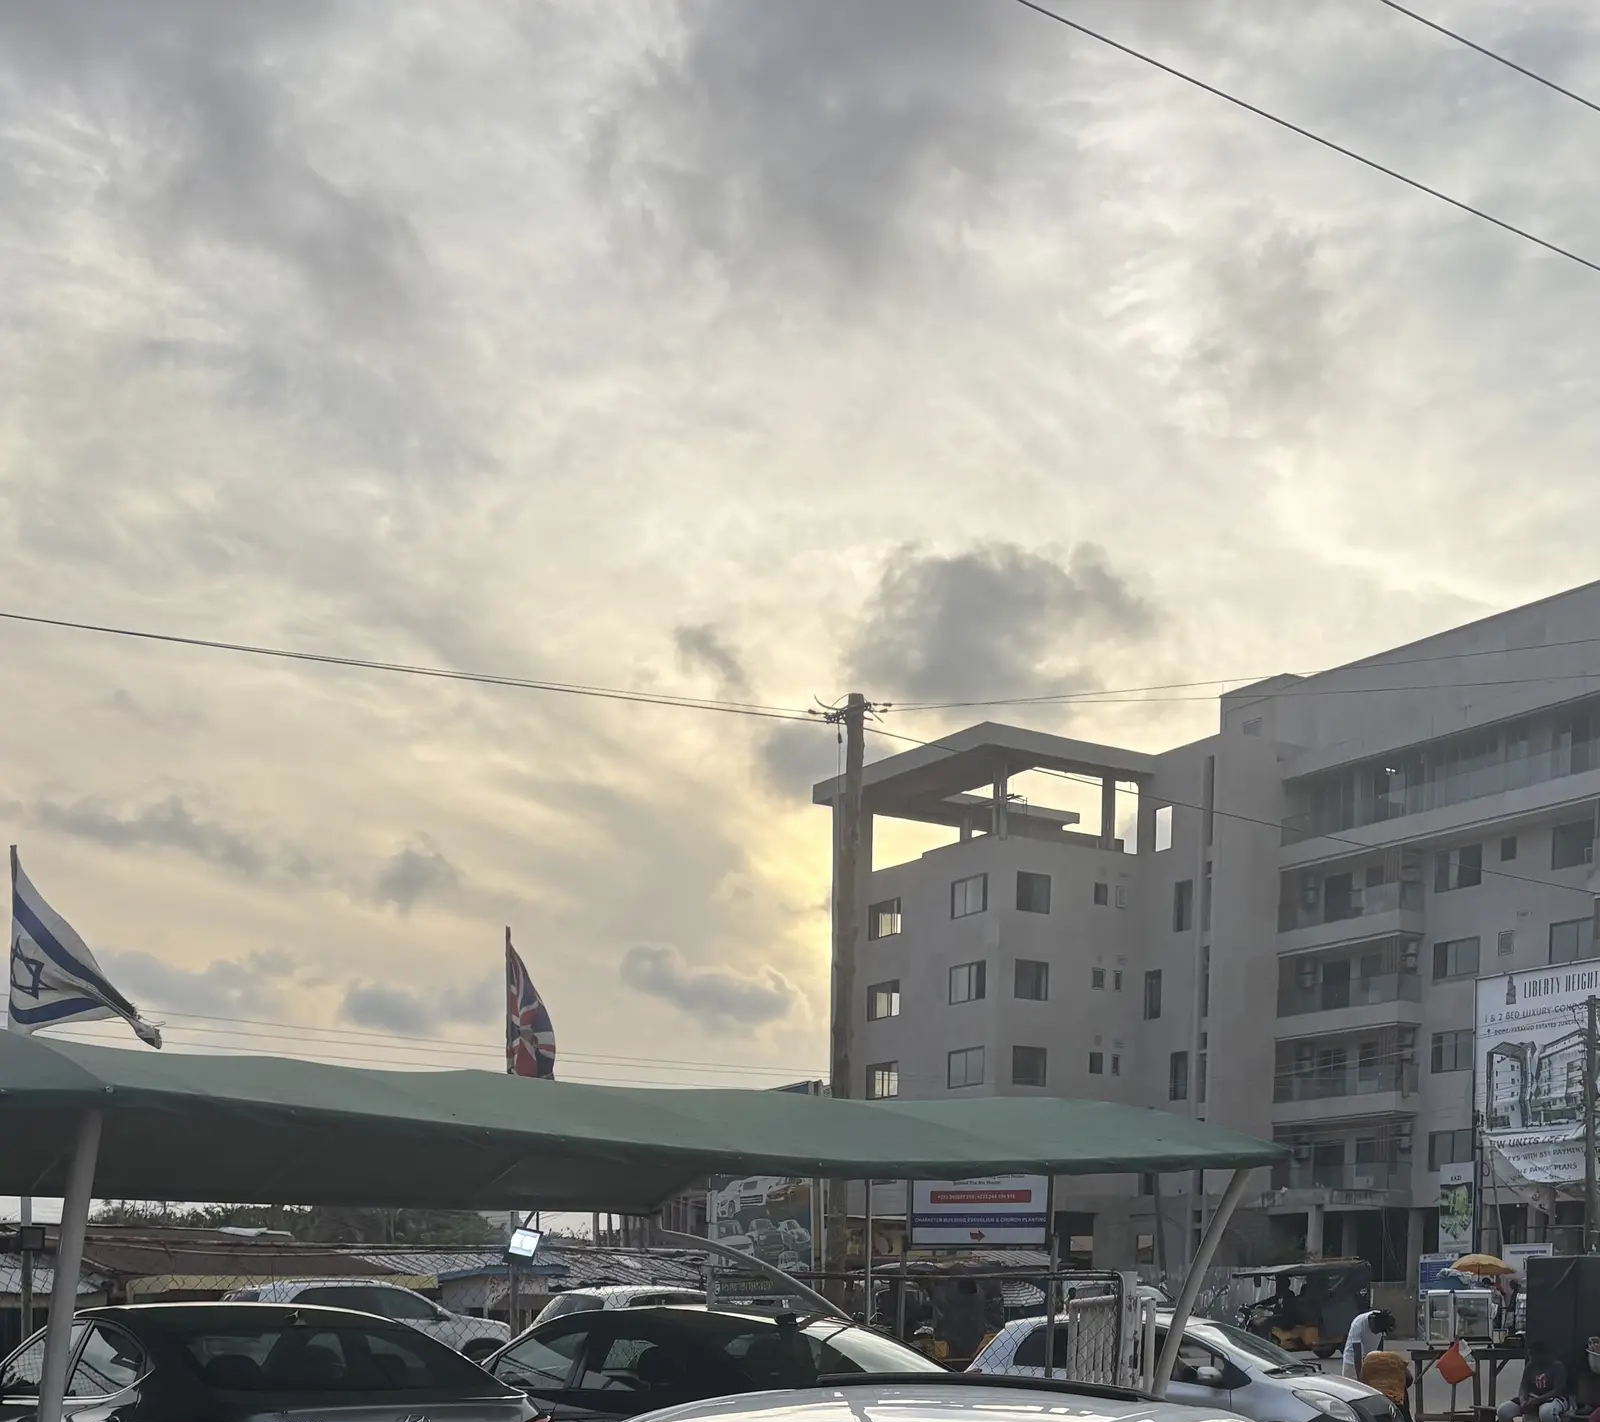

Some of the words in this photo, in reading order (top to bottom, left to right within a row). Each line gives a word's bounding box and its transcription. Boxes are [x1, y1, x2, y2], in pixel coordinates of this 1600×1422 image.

[1524, 977, 1560, 999] LIBERTY
[1565, 971, 1600, 992] HEIGHT
[1498, 1013, 1503, 1021] 2
[1505, 1010, 1520, 1020] BED
[1522, 1006, 1552, 1019] LUXURY
[1508, 1136, 1540, 1149] UNITS
